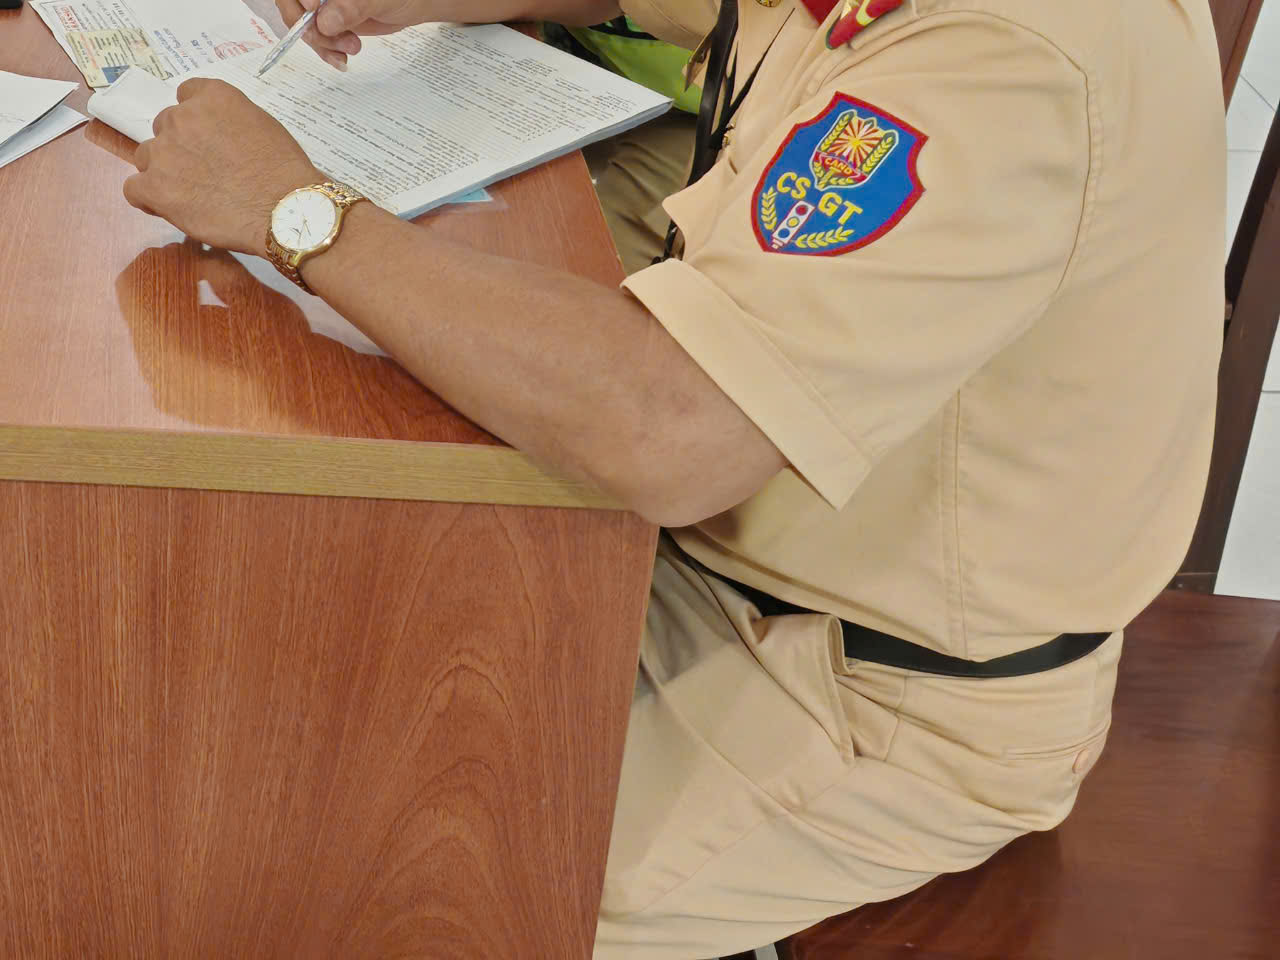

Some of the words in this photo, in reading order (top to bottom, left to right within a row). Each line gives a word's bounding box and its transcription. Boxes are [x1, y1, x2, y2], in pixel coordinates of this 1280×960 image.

[824, 157, 853, 176] CAND
[777, 171, 811, 199] CS
[818, 192, 863, 225] GT
